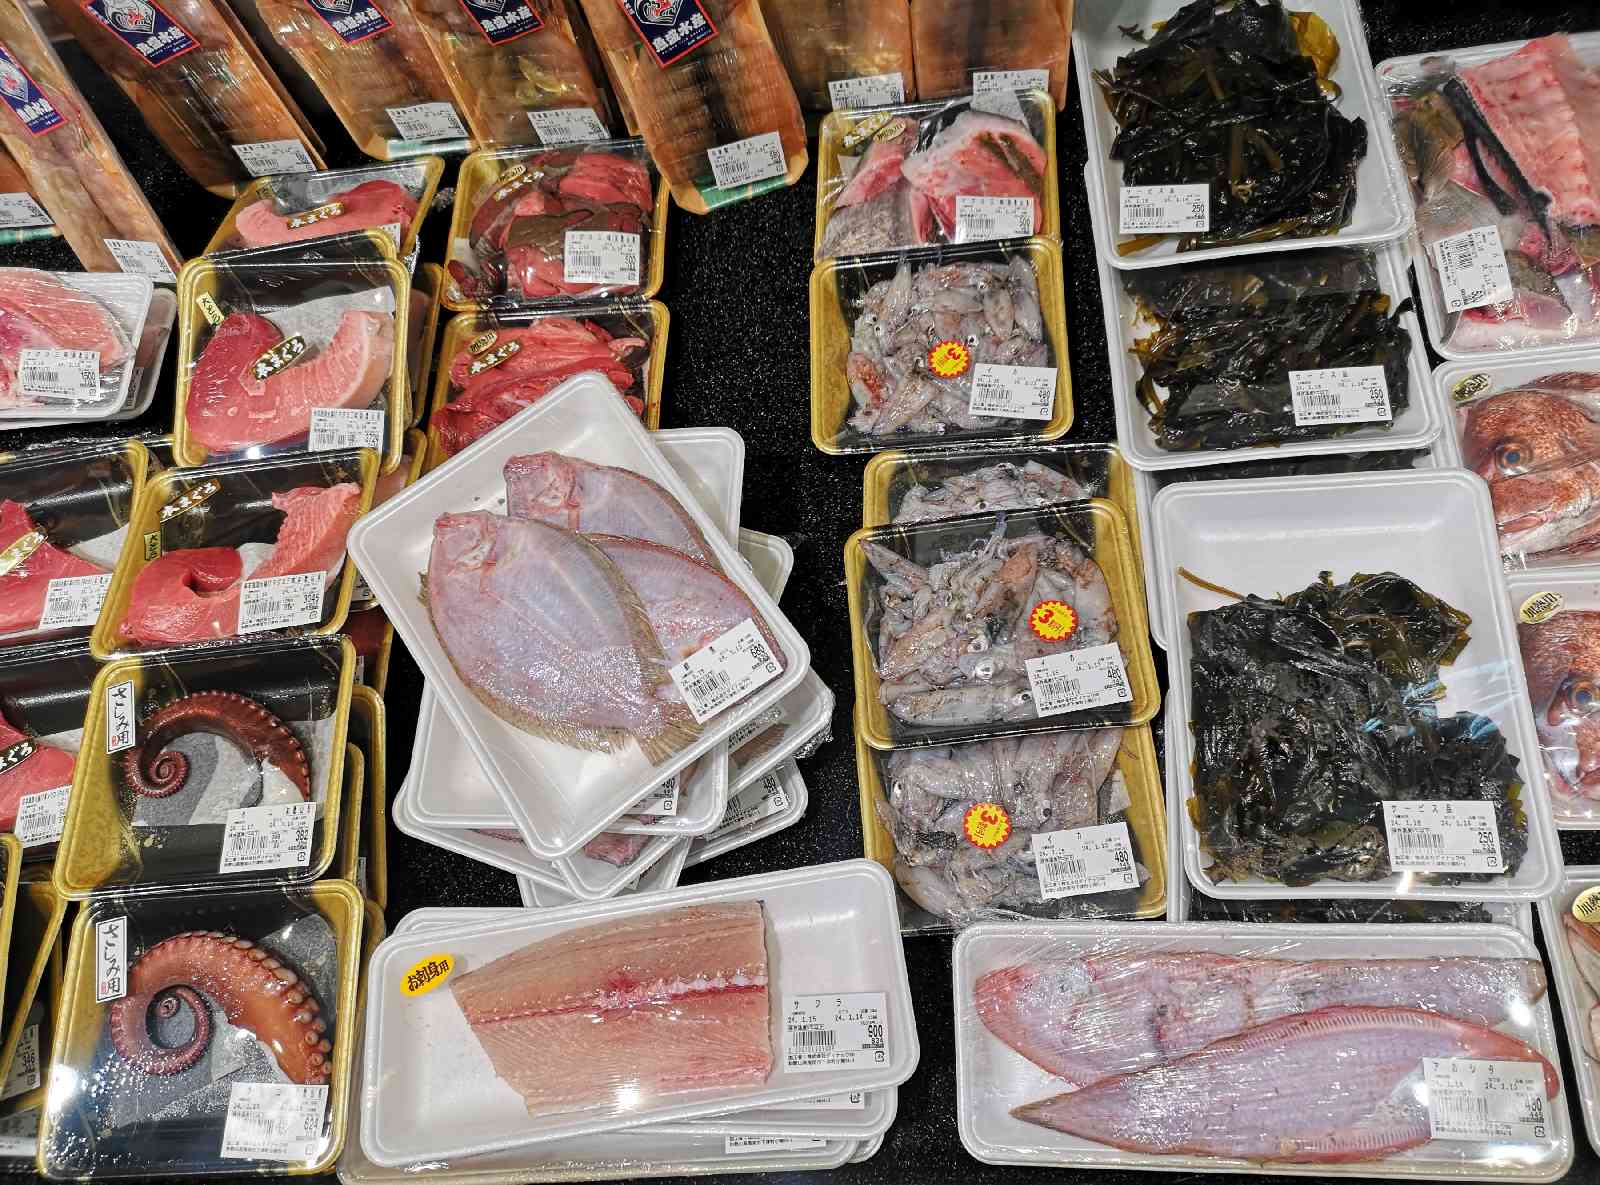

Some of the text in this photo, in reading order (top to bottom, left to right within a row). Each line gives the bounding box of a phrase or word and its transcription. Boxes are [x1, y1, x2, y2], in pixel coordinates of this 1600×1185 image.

[1192, 204, 1205, 213] 250
[1369, 389, 1384, 399] 250
[750, 643, 765, 658] 680
[1107, 668, 1121, 679] 480
[112, 687, 129, 744] さしみ用
[295, 829, 309, 841] 382
[1478, 831, 1493, 843] 250
[1115, 850, 1129, 862] 480
[102, 923, 121, 993] さしみ用
[407, 959, 449, 992] お刺身用
